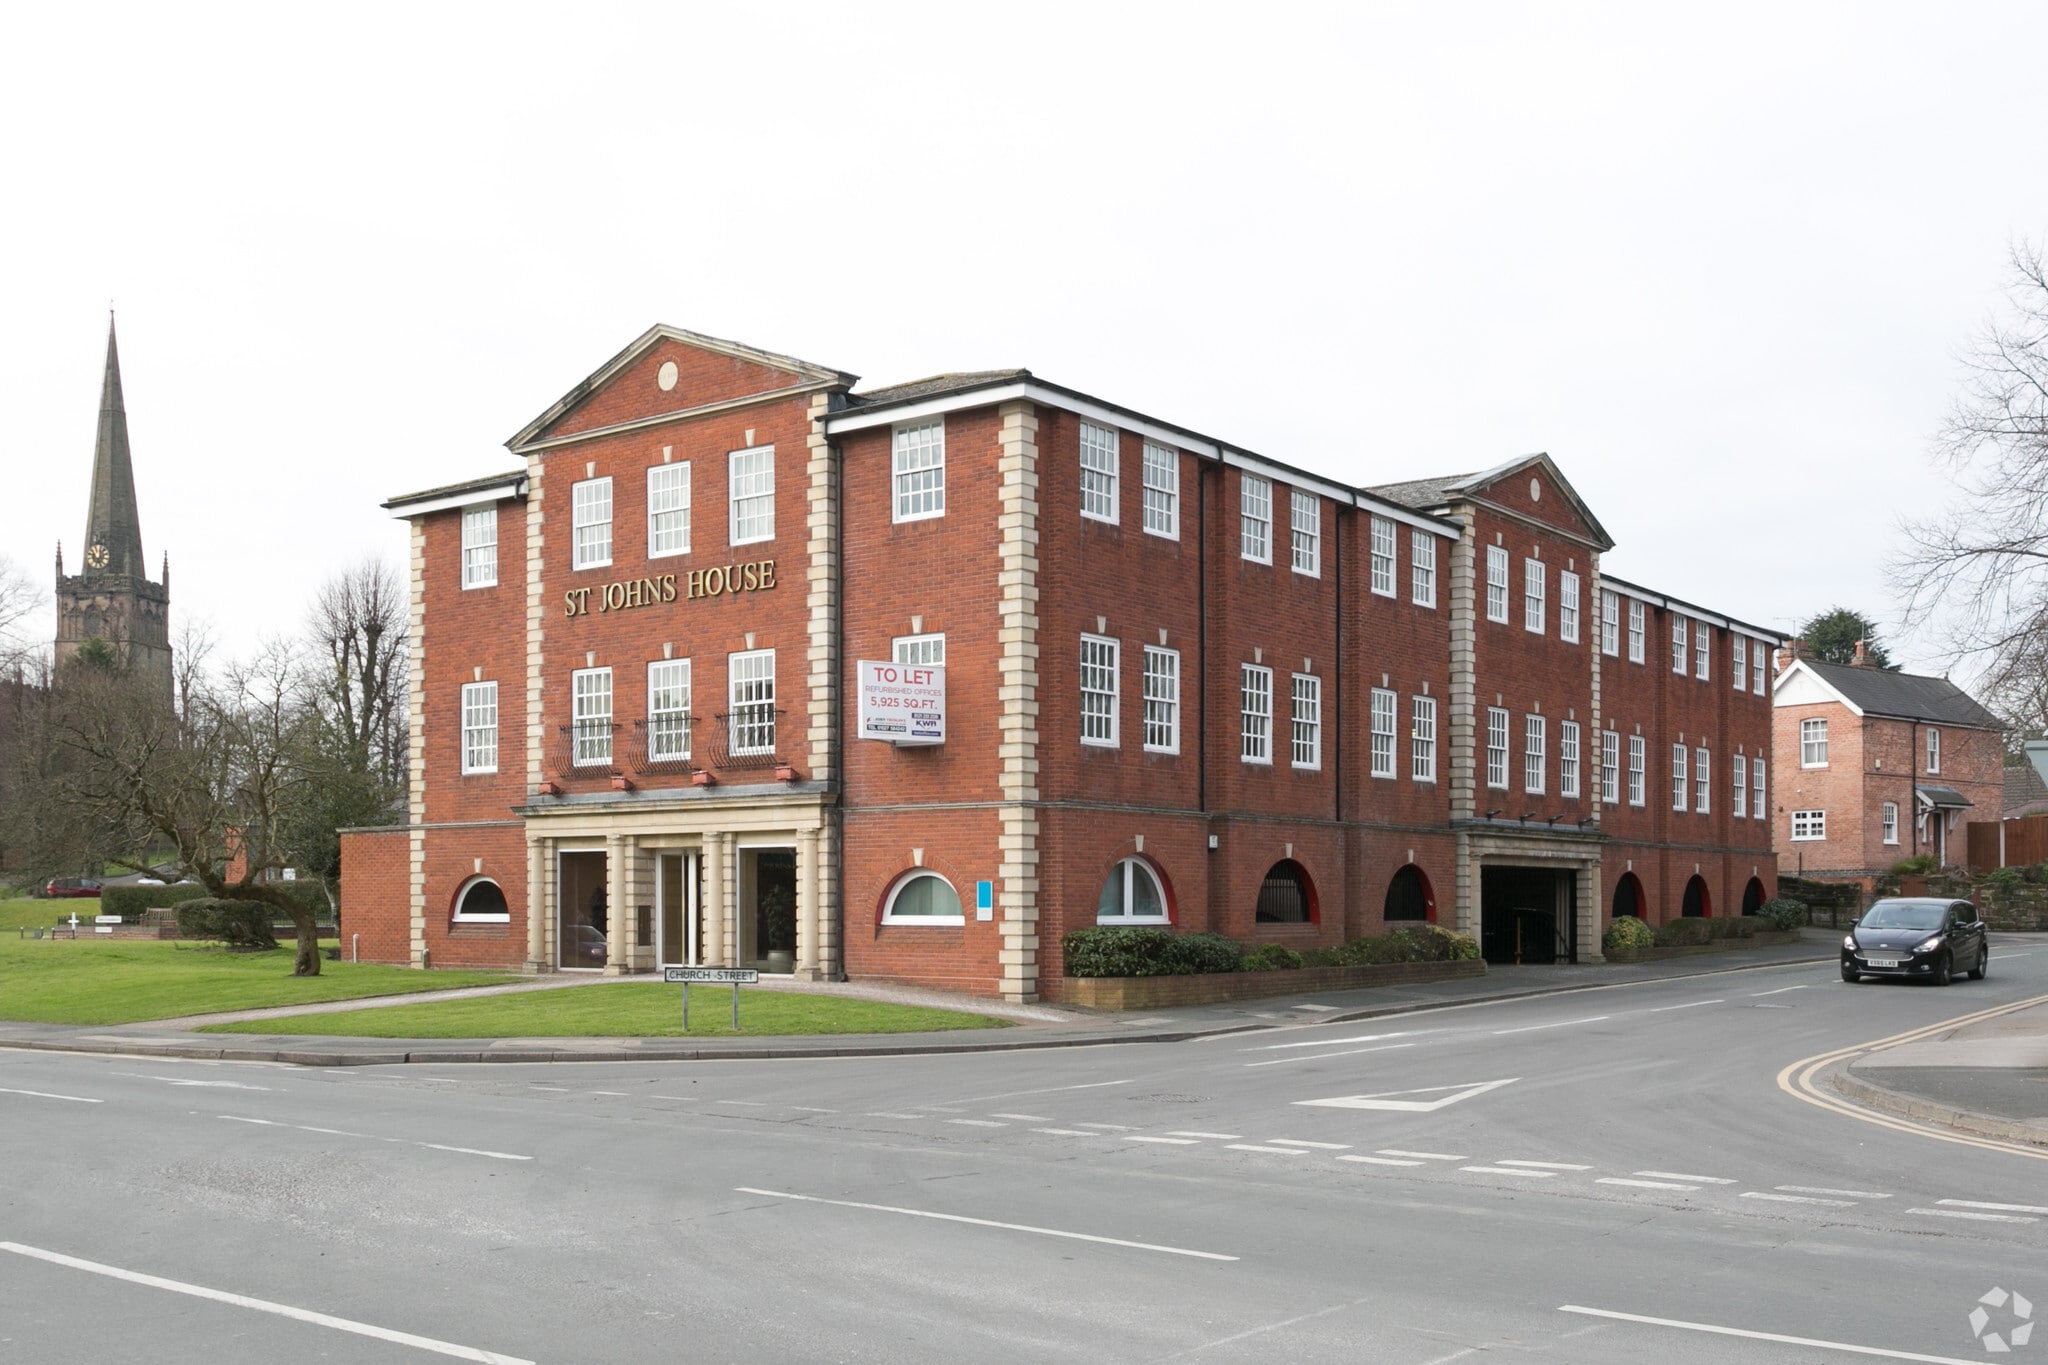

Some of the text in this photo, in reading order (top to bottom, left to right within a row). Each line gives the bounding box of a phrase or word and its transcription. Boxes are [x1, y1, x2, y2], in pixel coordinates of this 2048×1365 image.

[565, 559, 776, 617] ST JOHNS HOUSE
[873, 667, 934, 685] TO LET
[865, 686, 942, 697] REFURBISHED OFFICES
[870, 696, 900, 708] 5,925
[669, 970, 754, 981] CHURCH STREET
